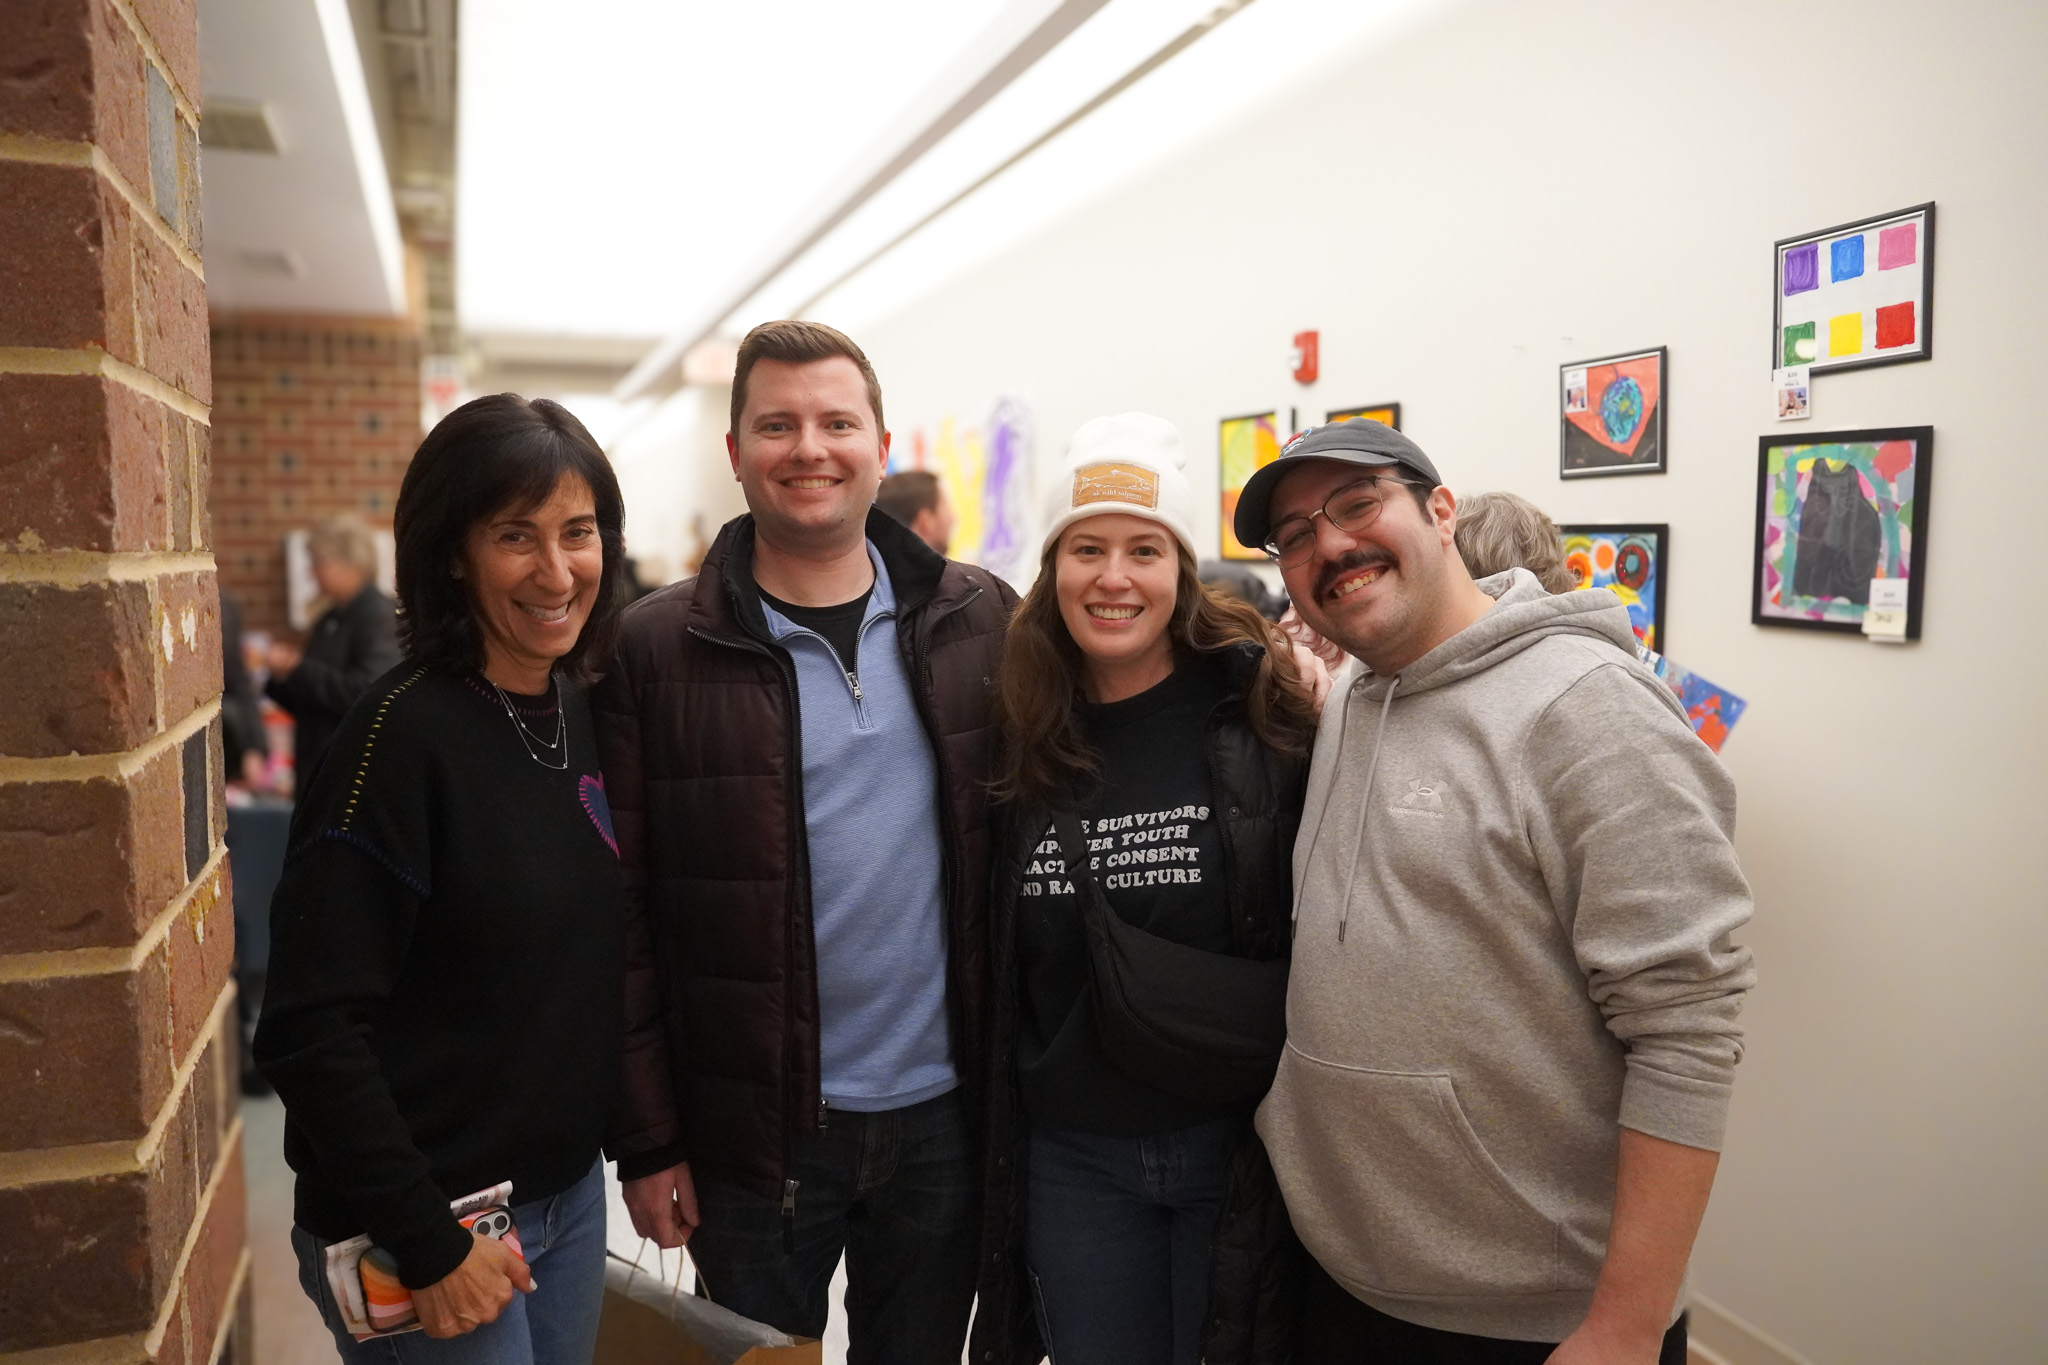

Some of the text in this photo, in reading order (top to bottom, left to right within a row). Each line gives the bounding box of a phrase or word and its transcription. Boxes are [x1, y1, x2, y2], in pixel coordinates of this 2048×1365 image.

[1097, 805, 1210, 833] SURVIVORS
[1121, 825, 1189, 846] YOUTH
[1106, 846, 1200, 868] CONSENT
[1020, 881, 1042, 897] ND
[1106, 868, 1202, 889] CULTURE
